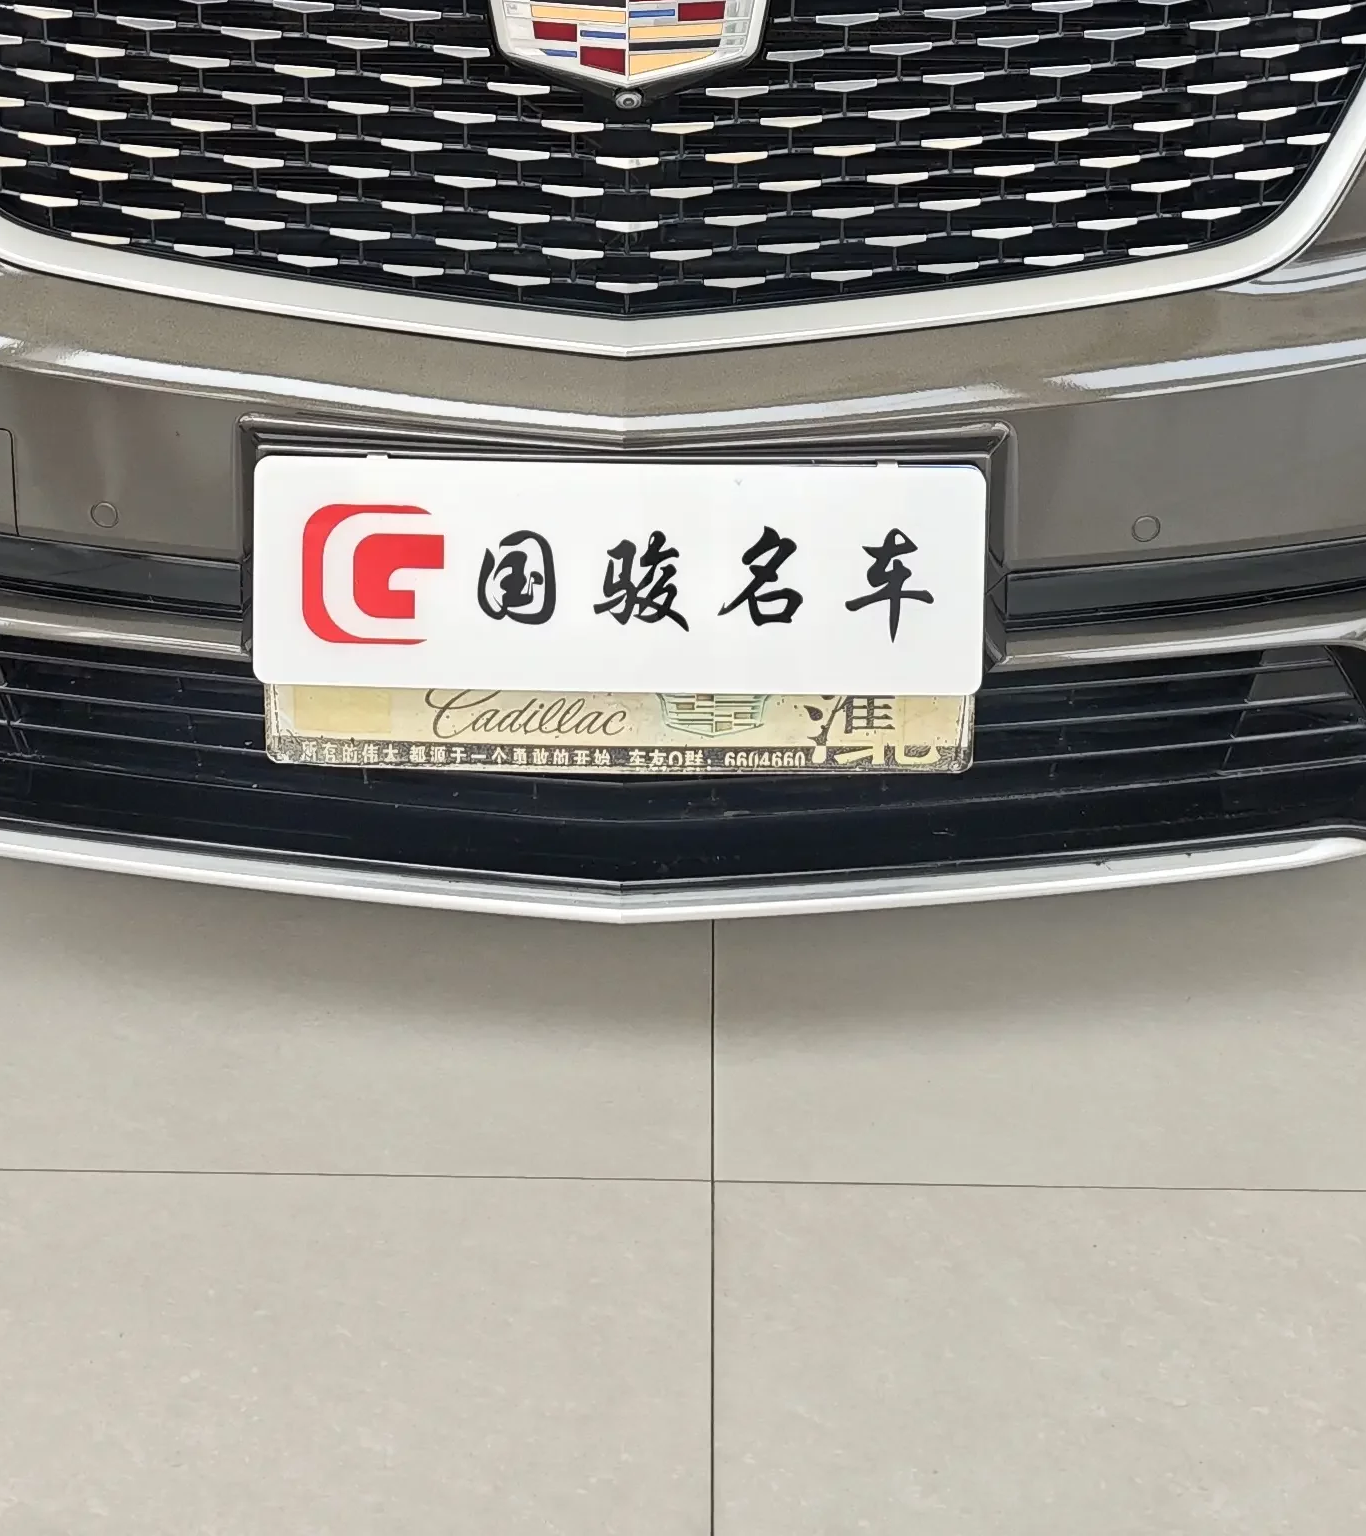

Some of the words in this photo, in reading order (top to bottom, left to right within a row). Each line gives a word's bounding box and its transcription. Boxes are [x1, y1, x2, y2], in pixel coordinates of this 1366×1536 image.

[477, 525, 934, 643] 国骏名车
[425, 689, 627, 739] Cadillac
